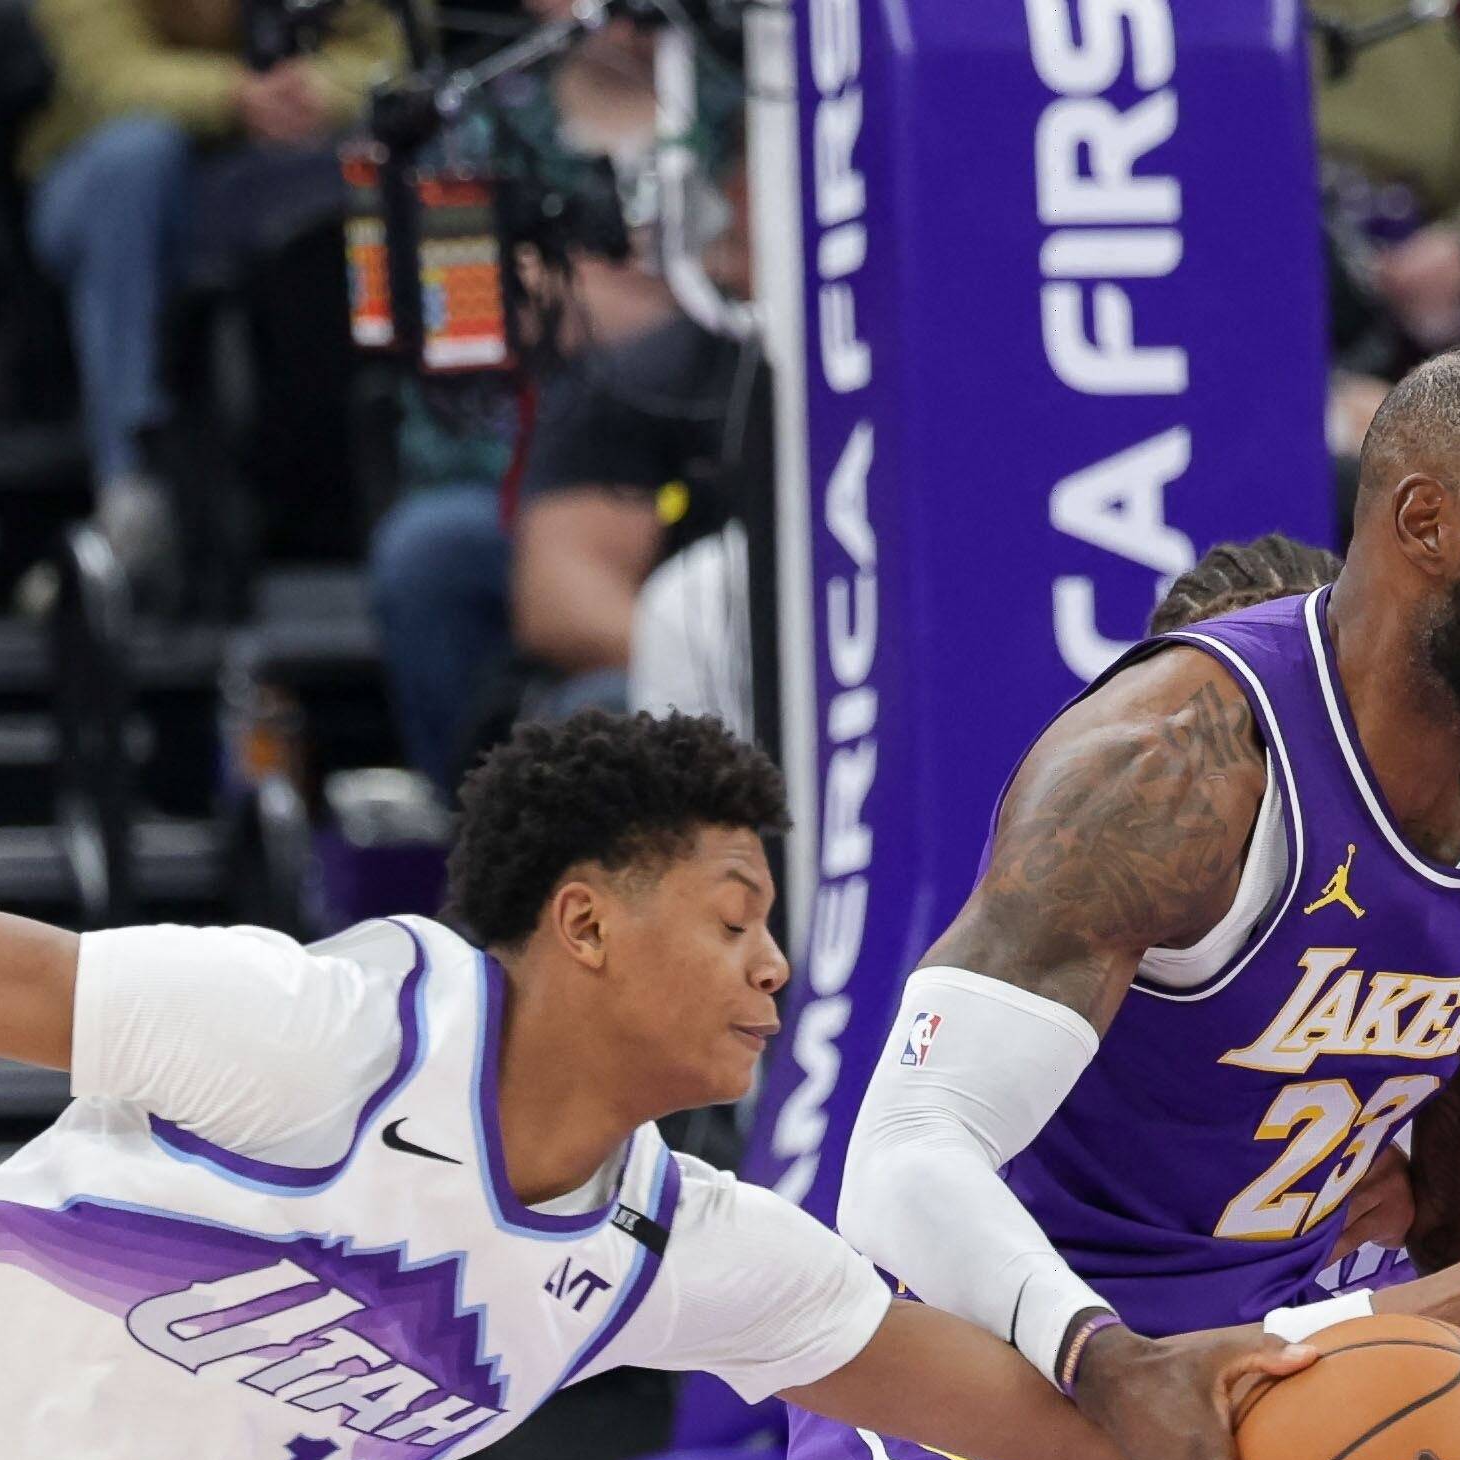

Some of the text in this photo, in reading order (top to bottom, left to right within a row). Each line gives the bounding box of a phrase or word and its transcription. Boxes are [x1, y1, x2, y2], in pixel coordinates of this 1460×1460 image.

[810, 0, 872, 394] FIRS
[1027, 0, 1190, 395] FIRS
[1212, 1074, 1440, 1240] 23
[126, 1258, 508, 1447] UTAH
